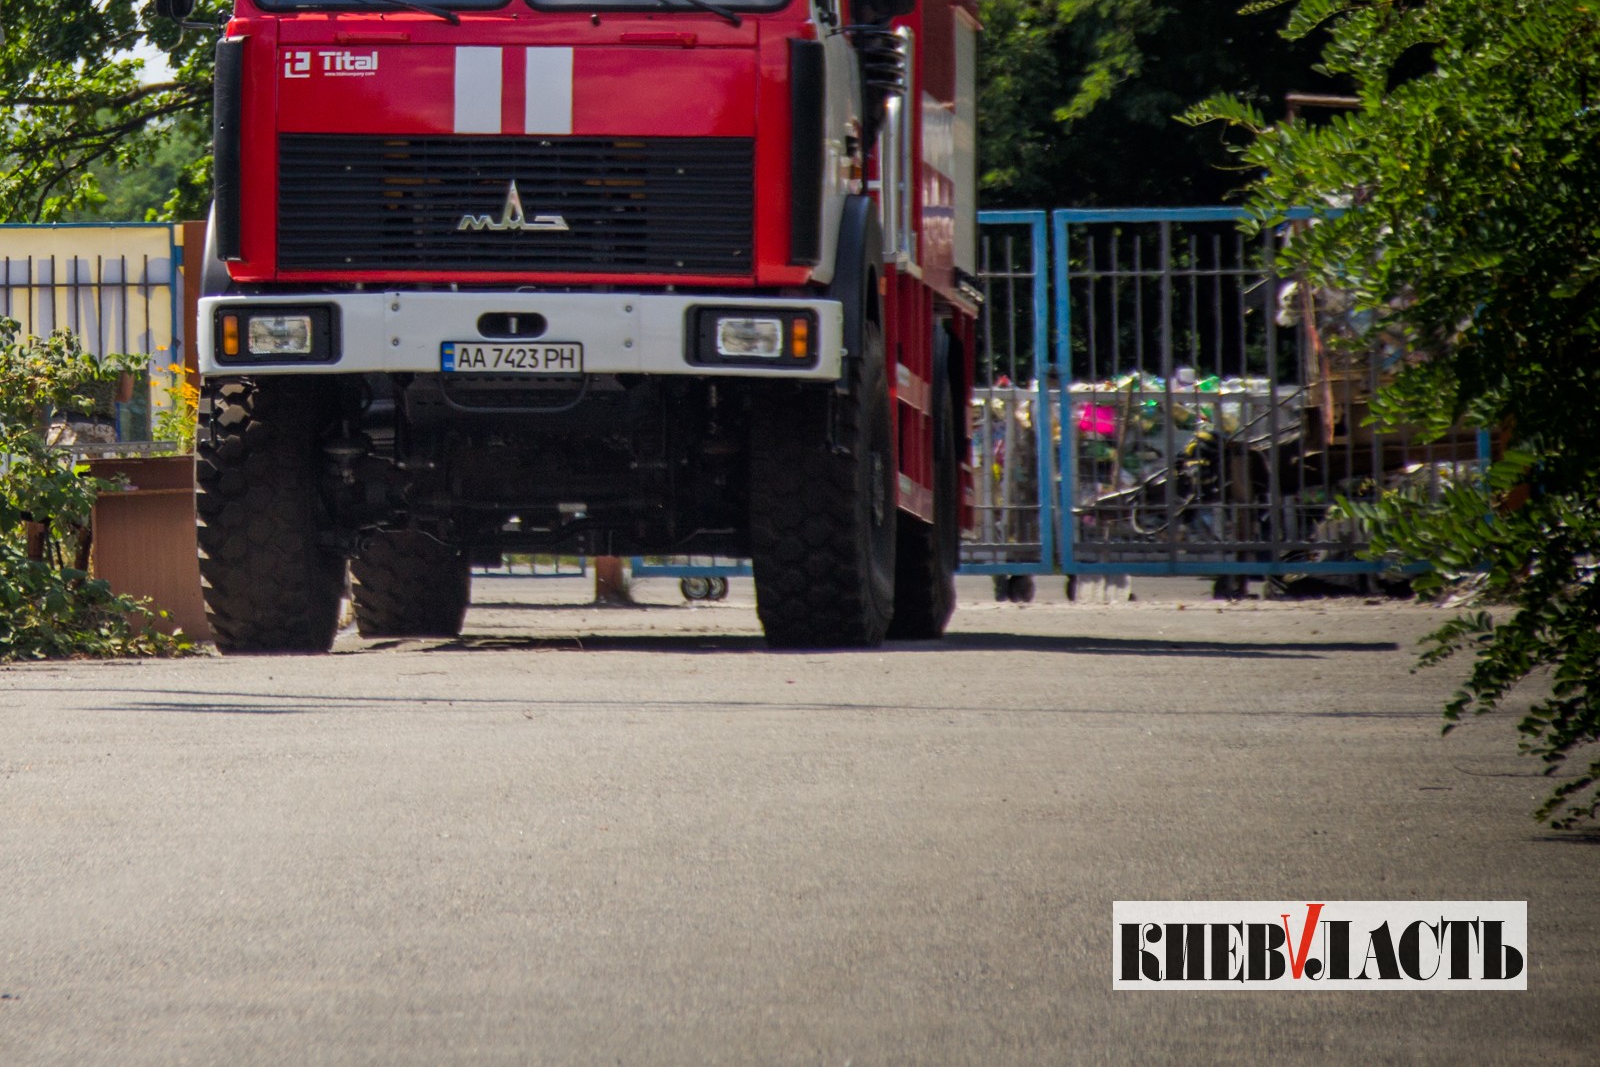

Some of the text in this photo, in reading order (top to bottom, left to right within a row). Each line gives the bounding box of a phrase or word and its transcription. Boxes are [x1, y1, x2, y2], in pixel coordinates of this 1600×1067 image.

[318, 51, 378, 71] Tital
[458, 347, 575, 369] AA 7423 PH
